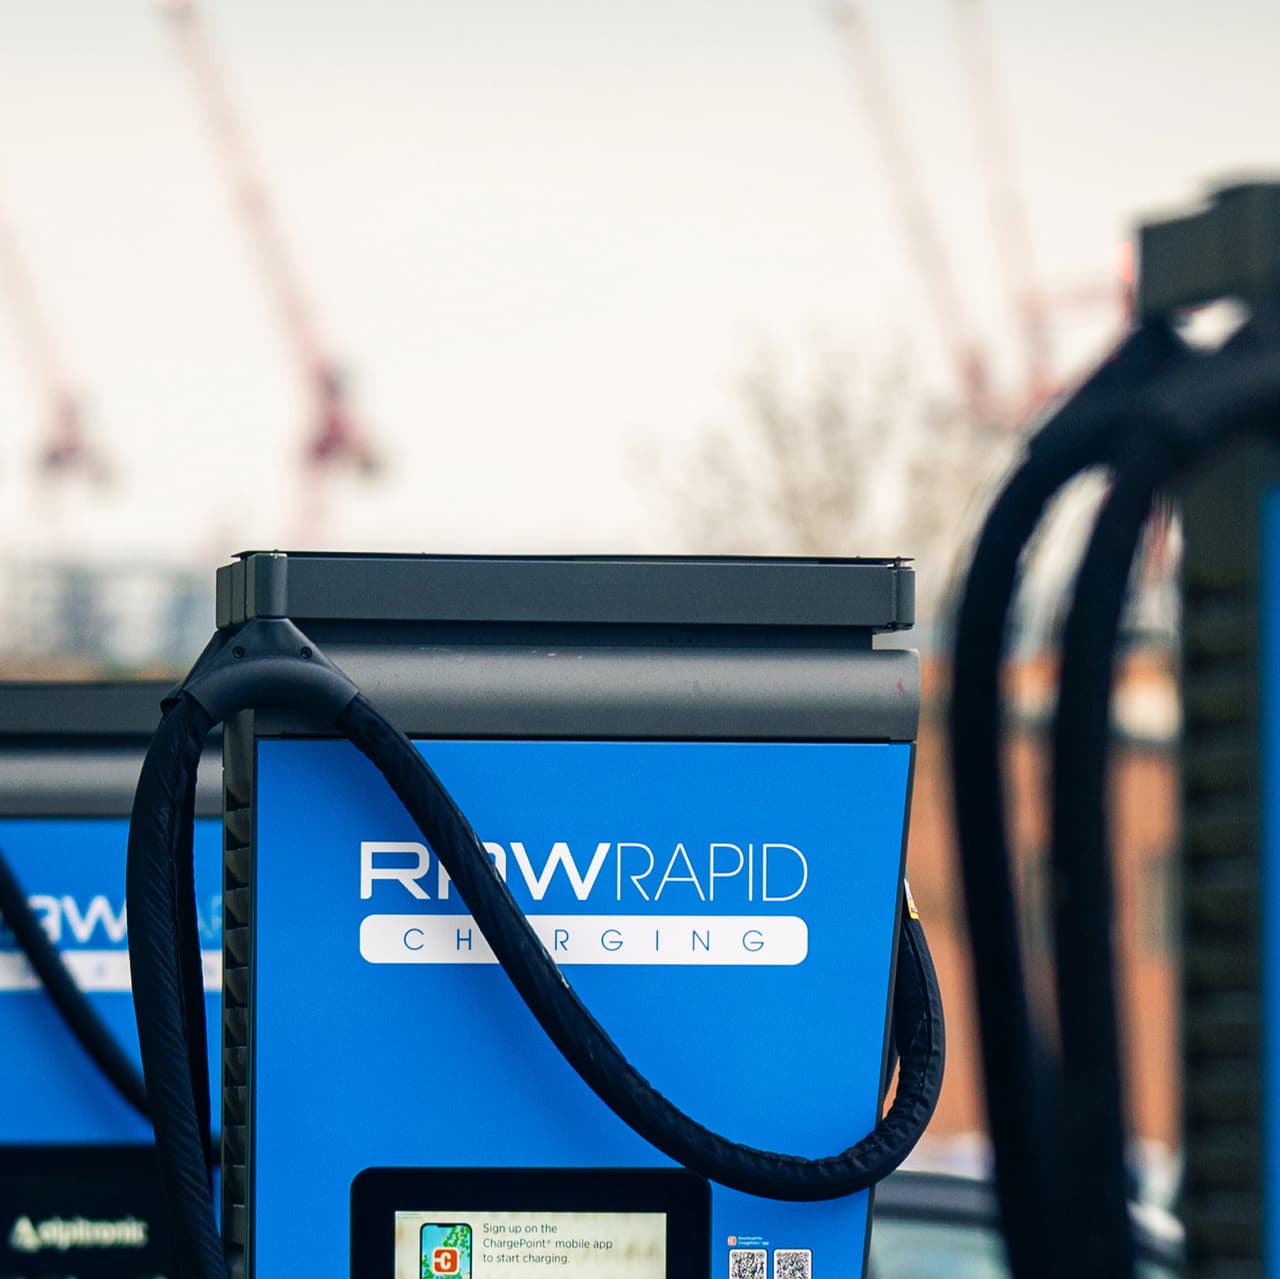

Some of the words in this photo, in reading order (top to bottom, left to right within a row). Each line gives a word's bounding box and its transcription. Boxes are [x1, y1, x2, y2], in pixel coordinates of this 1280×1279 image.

[403, 928, 765, 951] CHRGING
[483, 1223, 506, 1234] Sign
[509, 1225, 522, 1234] up
[524, 1225, 537, 1233] on
[541, 1223, 558, 1233] the
[555, 1238, 590, 1248] mobile
[593, 1240, 613, 1250] app
[483, 1254, 494, 1263] to
[496, 1254, 520, 1263] start
